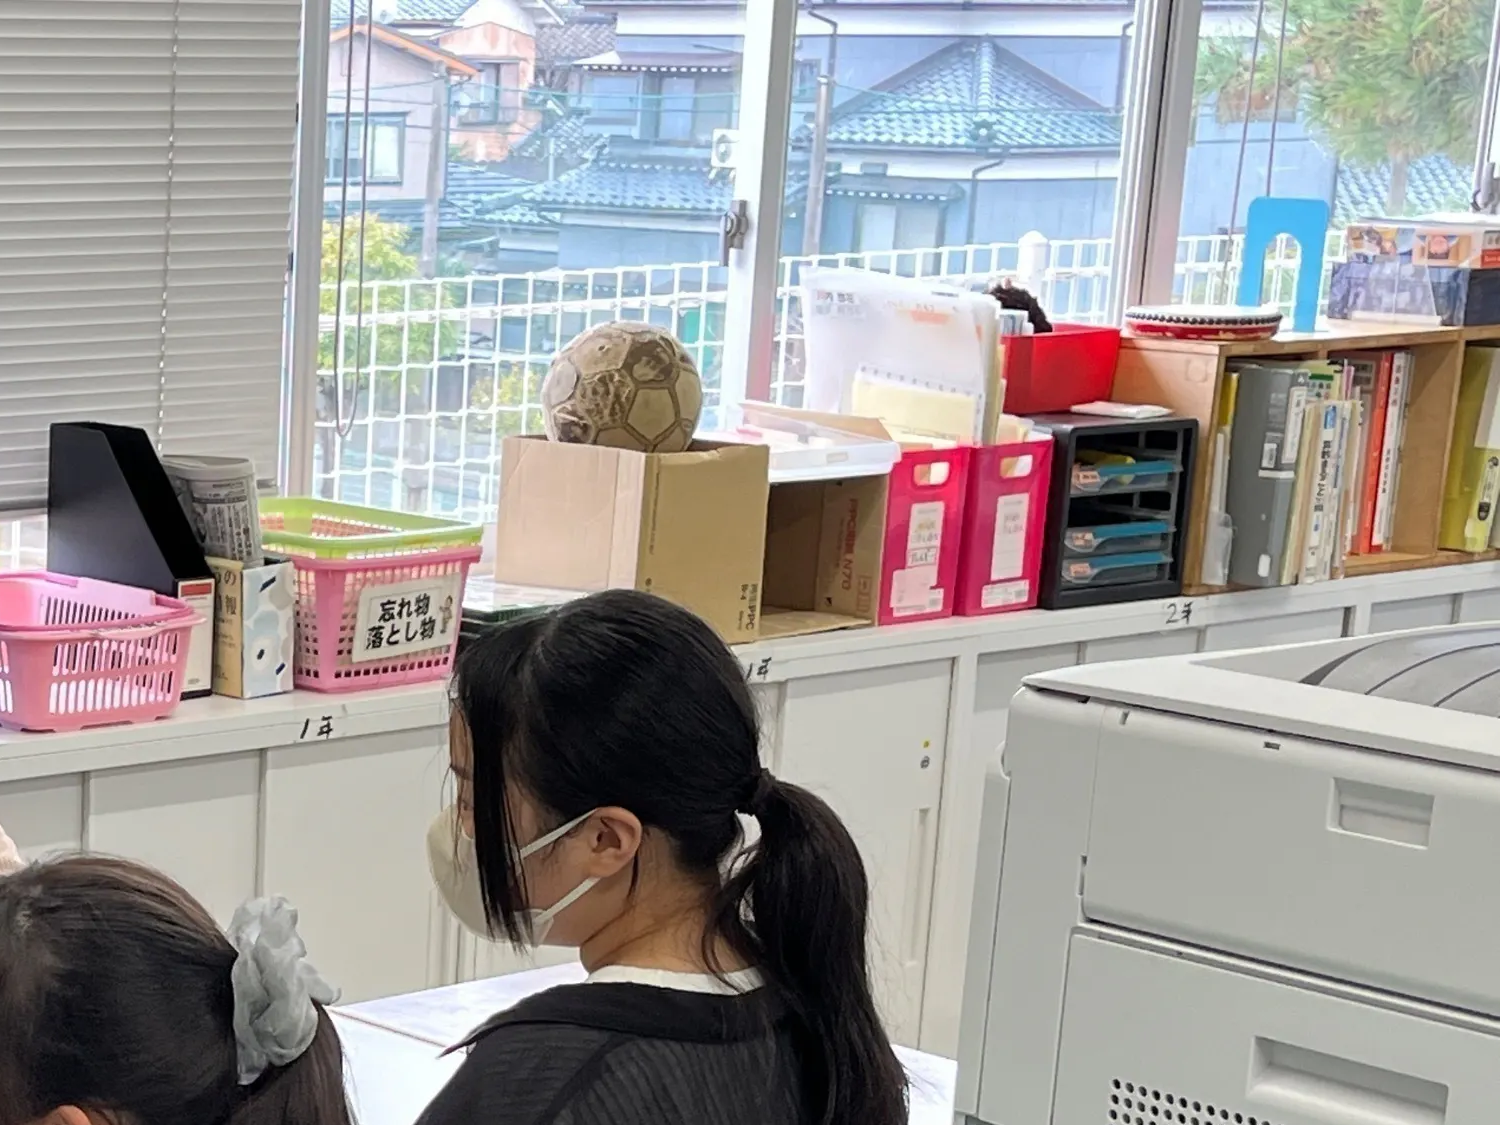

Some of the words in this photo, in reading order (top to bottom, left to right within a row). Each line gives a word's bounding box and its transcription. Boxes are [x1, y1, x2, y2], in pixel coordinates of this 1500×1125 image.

[378, 593, 430, 623] 忘れ物
[366, 616, 436, 650] 落とし物
[300, 715, 333, 740] 1年
